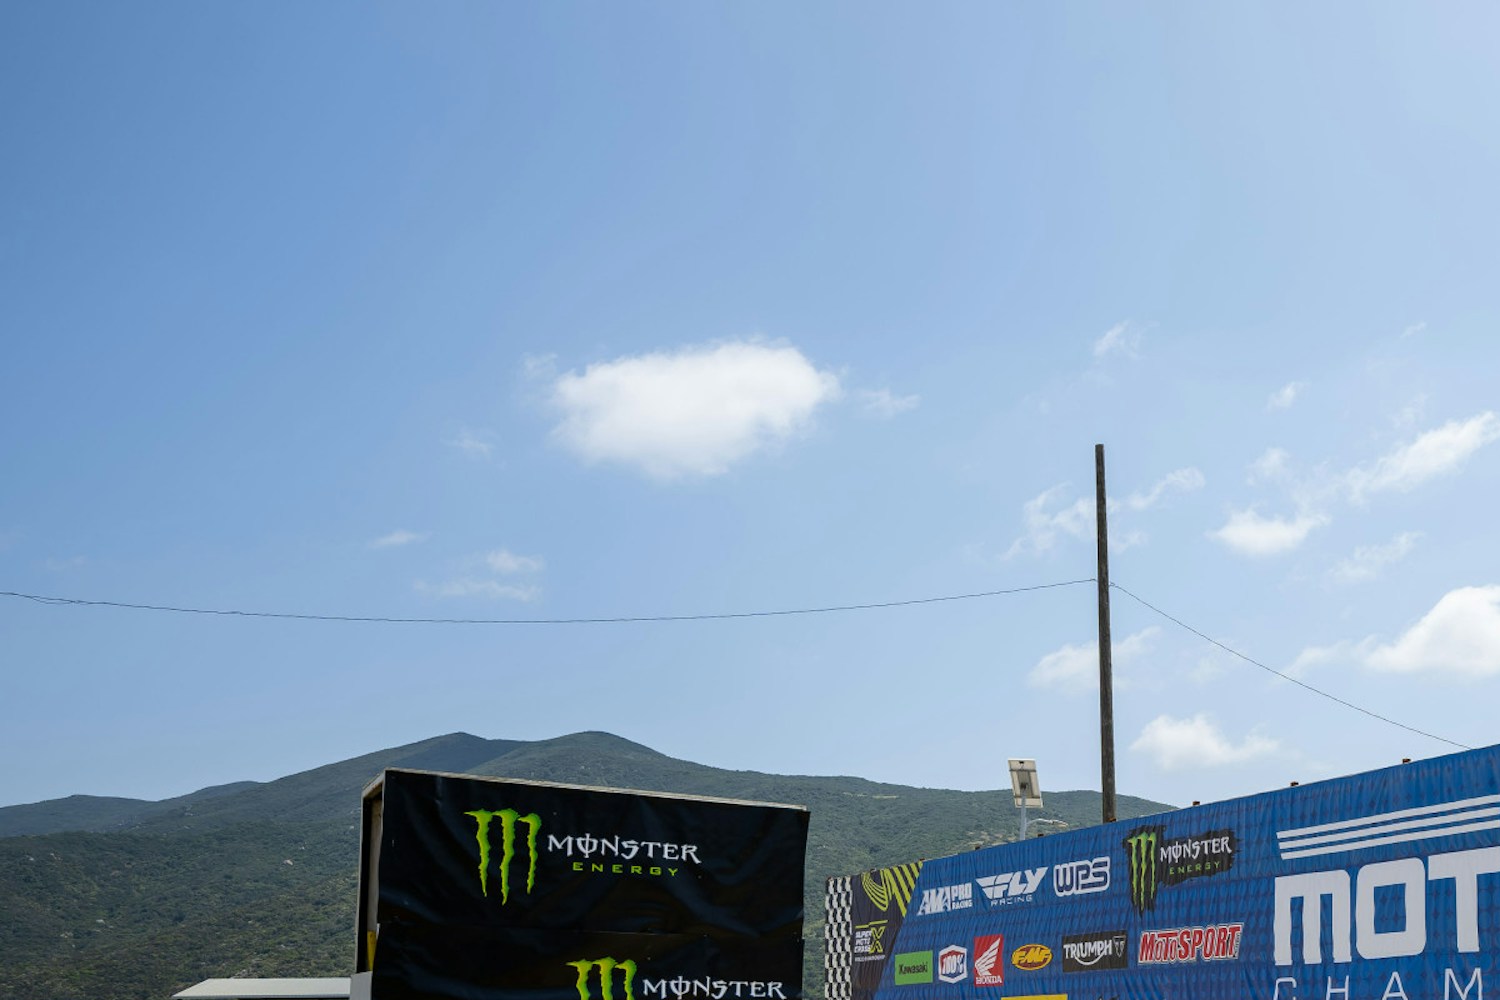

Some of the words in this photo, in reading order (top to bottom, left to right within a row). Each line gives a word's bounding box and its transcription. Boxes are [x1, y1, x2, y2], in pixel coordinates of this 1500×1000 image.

[547, 833, 702, 864] MONSTER
[1160, 836, 1232, 863] MONSTER
[572, 861, 678, 877] ENERGY
[1053, 856, 1110, 897] WPS
[1169, 861, 1220, 875] ENERGY
[951, 883, 972, 899] PRO
[975, 867, 1048, 899] FLY
[990, 894, 1033, 906] RACING
[1012, 946, 1052, 966] FMF
[1063, 939, 1112, 965] TRIUMPH
[898, 961, 928, 976] Kawasaki
[643, 976, 787, 1000] MONSTER
[975, 975, 1002, 985] HONDA
